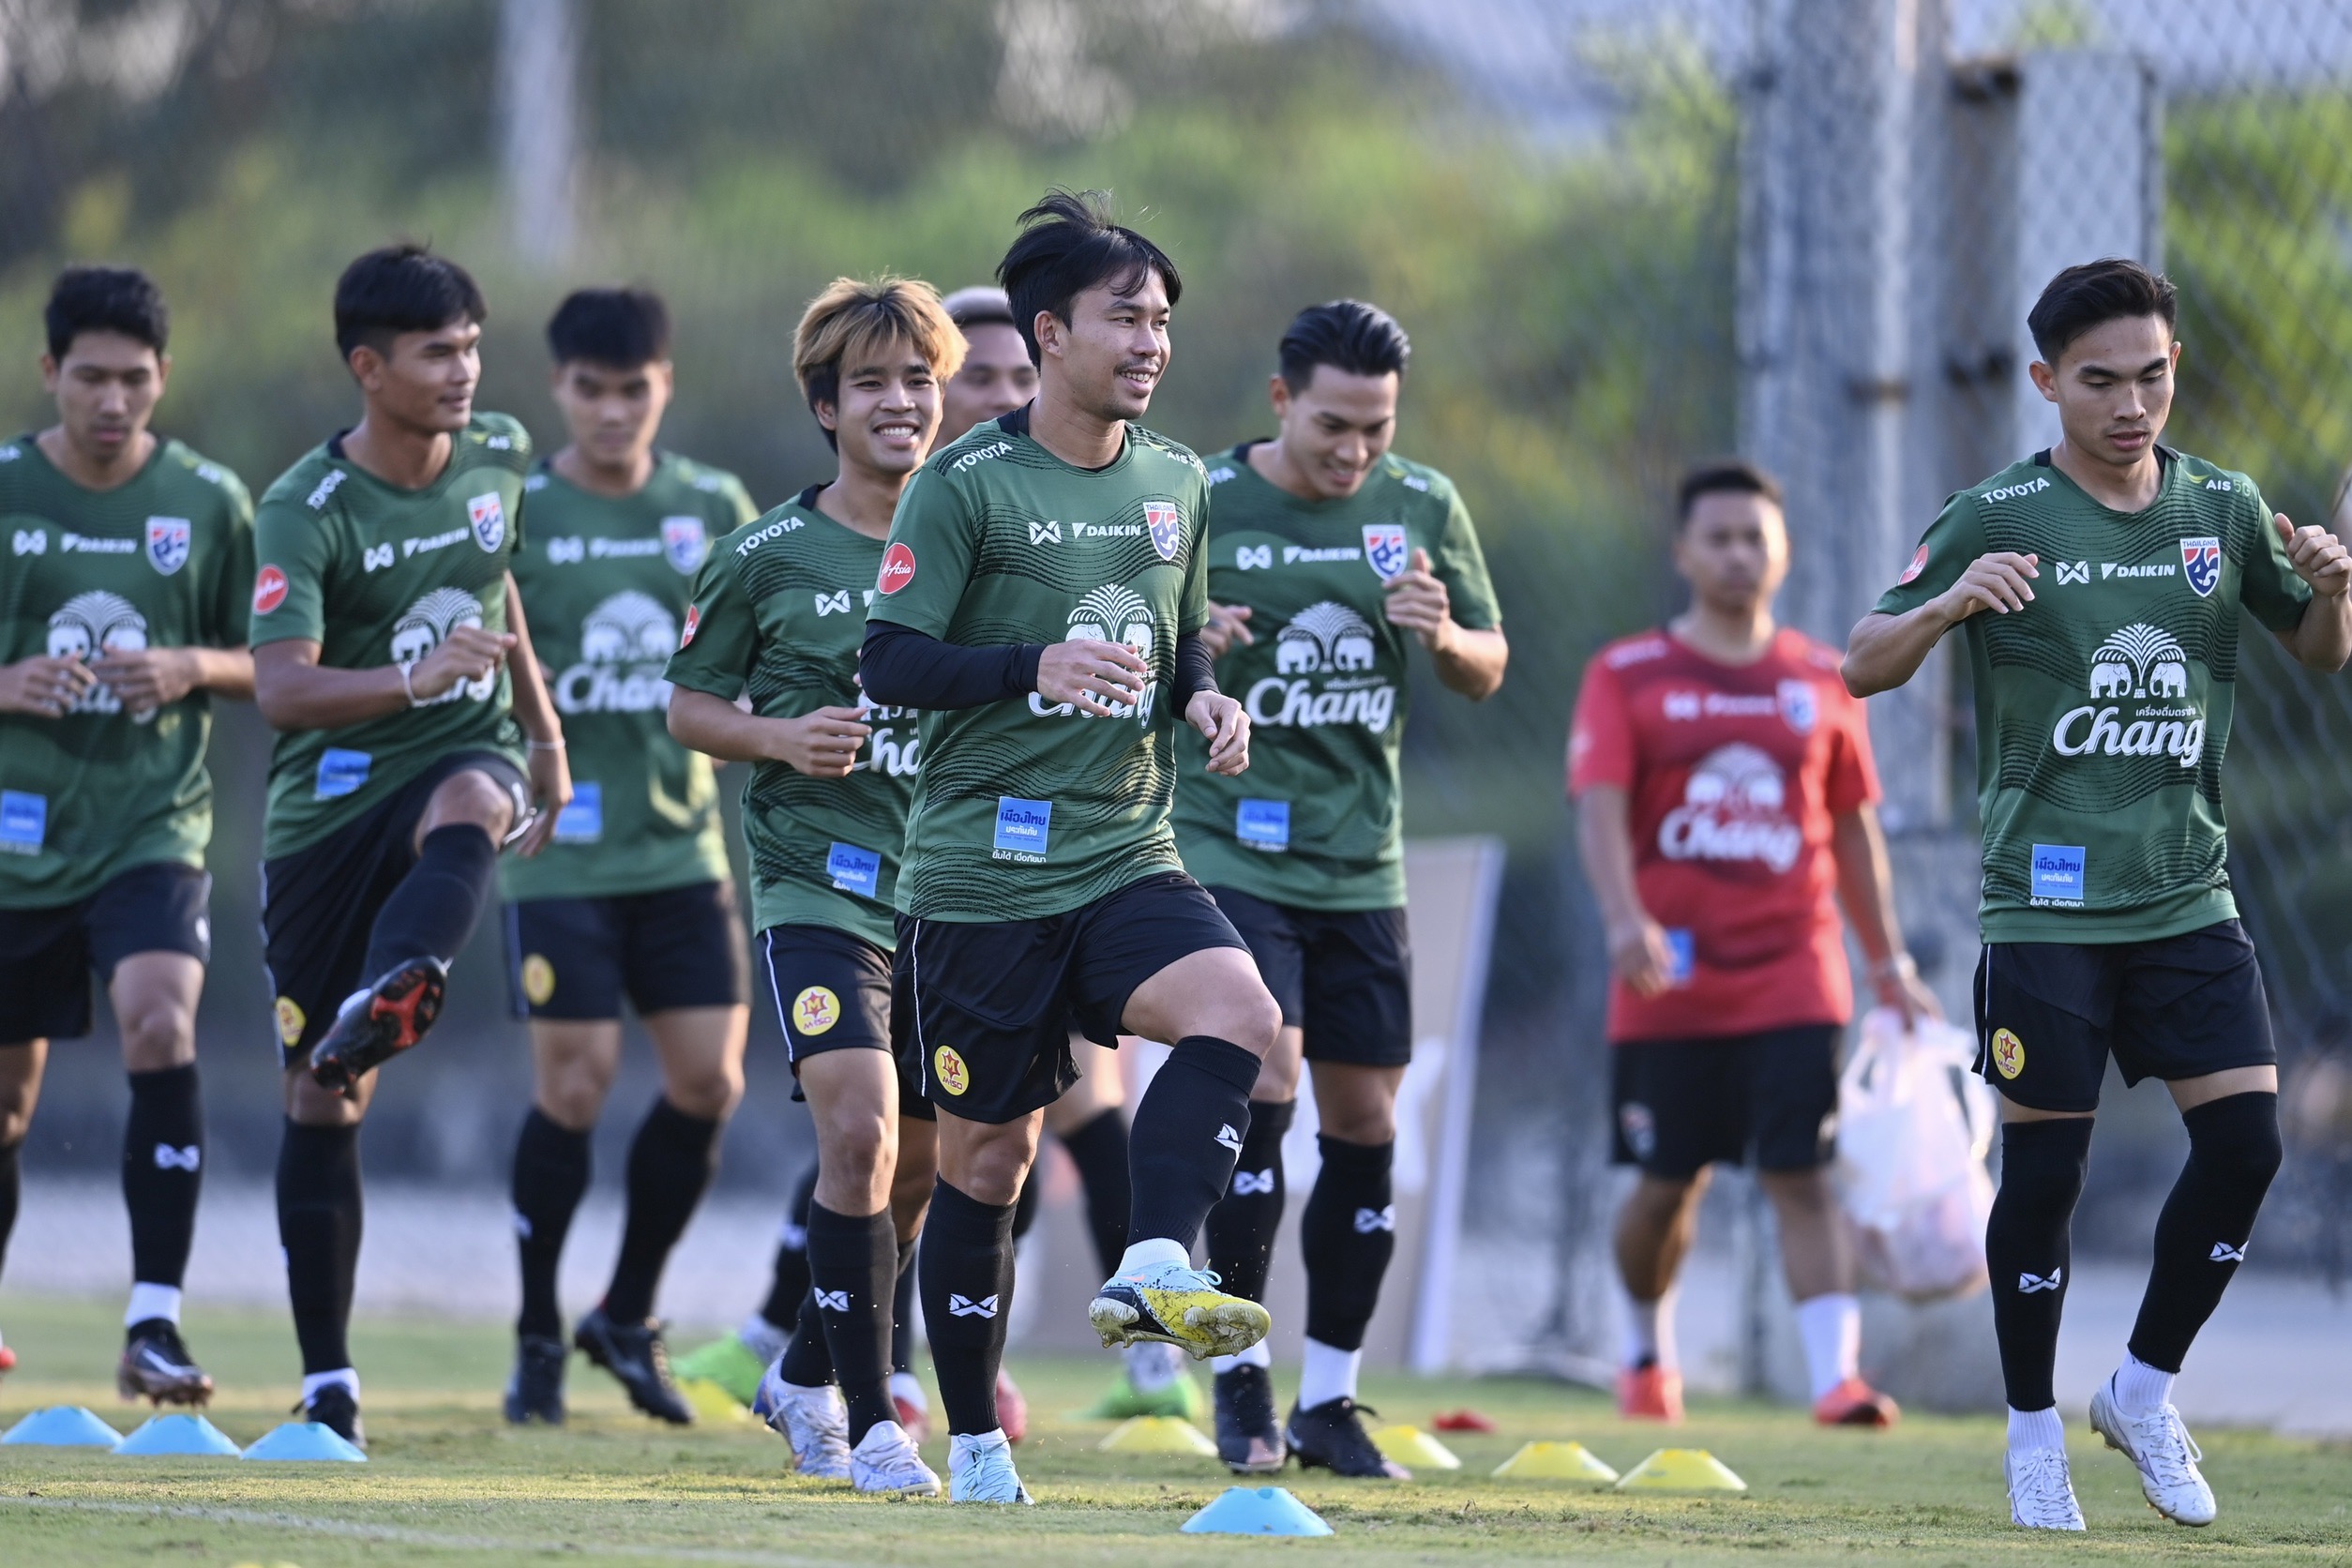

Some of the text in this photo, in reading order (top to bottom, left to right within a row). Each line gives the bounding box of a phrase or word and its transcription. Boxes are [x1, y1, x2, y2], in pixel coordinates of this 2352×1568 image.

[953, 441, 1013, 473] TOYOTA
[1167, 451, 1188, 464] AIS
[1981, 476, 2051, 505] TOYOTA
[2206, 478, 2251, 497] AIS 5G
[735, 516, 806, 557] TOYOTA
[1088, 525, 1141, 536] DAIKIN
[2182, 539, 2217, 548] THAILAND
[2117, 565, 2176, 578] DAIKIN
[1244, 676, 1396, 734] Chang
[2053, 705, 2205, 768] Chang
[1000, 808, 1047, 826] เมืองไทย
[2034, 856, 2081, 873] เมืองไทย
